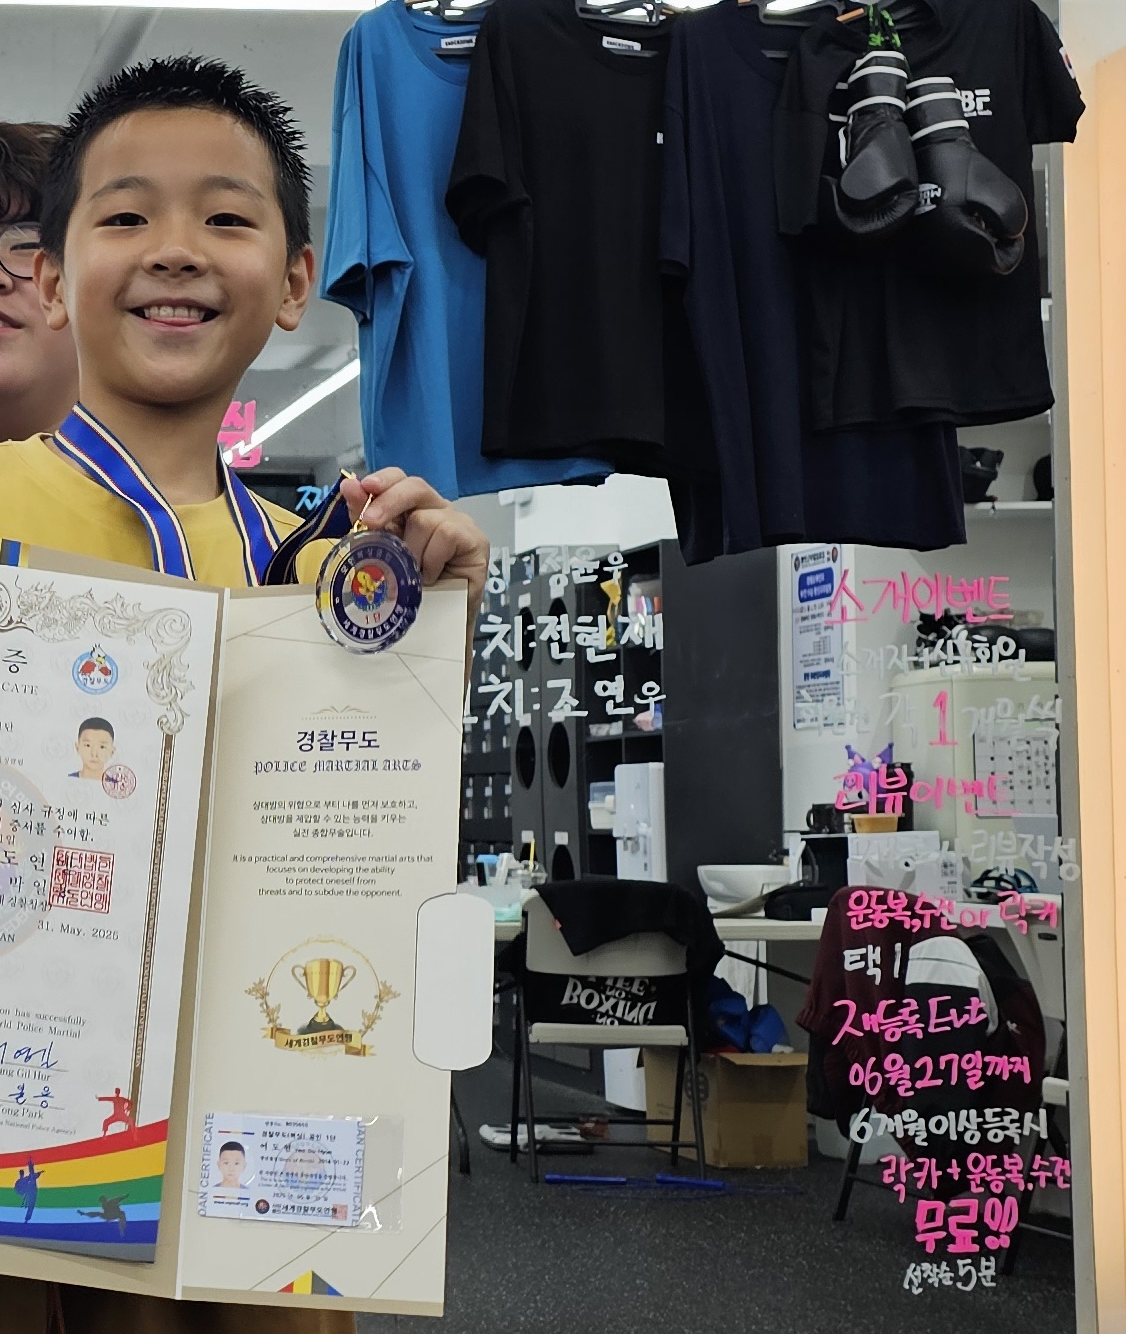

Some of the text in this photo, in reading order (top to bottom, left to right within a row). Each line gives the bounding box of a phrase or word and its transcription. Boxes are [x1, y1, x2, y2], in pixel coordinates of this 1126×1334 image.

[929, 690, 959, 746] 1
[297, 730, 380, 752] 경찰무도
[254, 759, 422, 776] POLICE MARTIAL ARTS
[233, 854, 238, 862] It
[254, 855, 287, 864] practical
[306, 855, 367, 864] comprehensive
[417, 854, 433, 862] that
[266, 865, 297, 873] focuses
[310, 865, 354, 875] developing
[371, 866, 396, 875] ability
[296, 877, 324, 886] protect
[326, 876, 355, 885] oneself
[357, 876, 376, 885] from
[259, 887, 287, 896] threats
[288, 887, 303, 896] and
[314, 888, 345, 896] subdue
[346, 888, 360, 896] the
[361, 889, 402, 898] opponent.
[843, 944, 882, 986] 택
[15, 1008, 31, 1018] has
[35, 1013, 87, 1027] successfully
[17, 1021, 44, 1033] Police
[49, 1026, 81, 1039] Martial
[204, 1113, 214, 1188] CERTIFICATE
